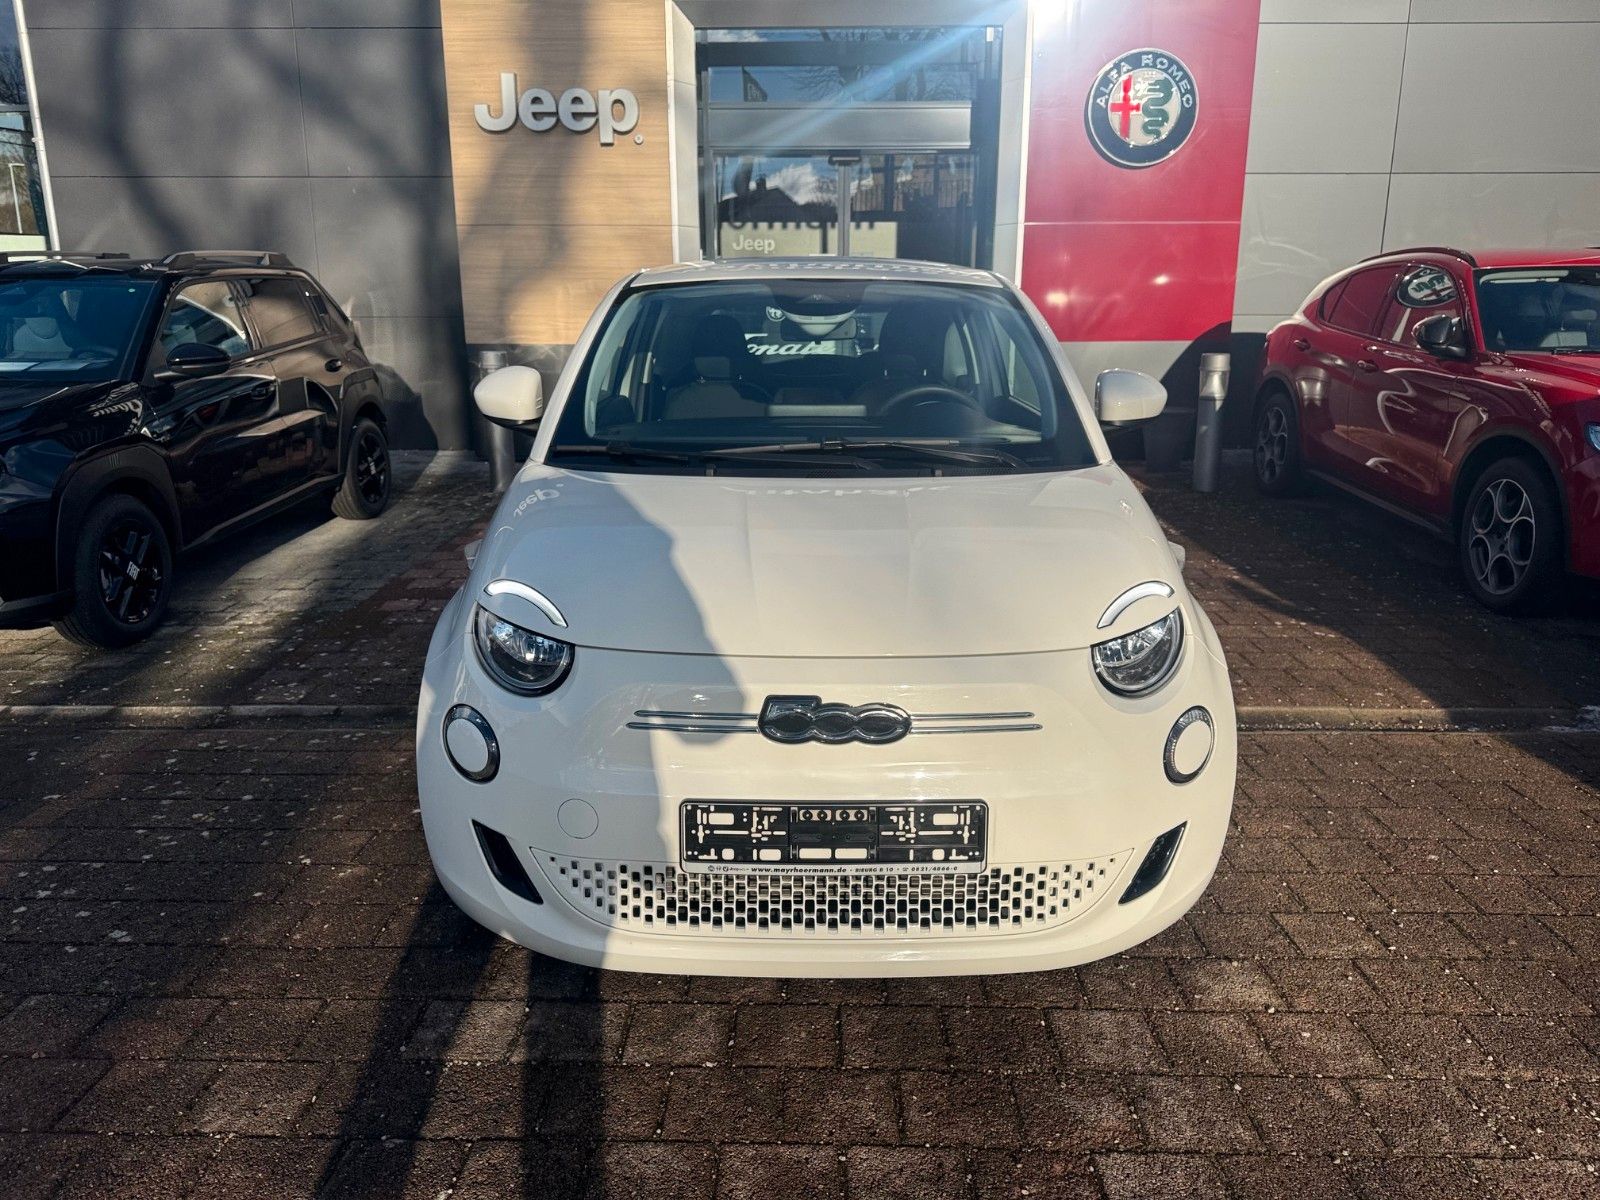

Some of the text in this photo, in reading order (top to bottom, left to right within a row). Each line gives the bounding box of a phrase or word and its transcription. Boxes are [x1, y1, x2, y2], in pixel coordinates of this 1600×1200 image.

[1096, 54, 1193, 109] ALFA ROMEO
[474, 72, 639, 146] Jeep
[732, 233, 776, 254] Jeep
[758, 694, 912, 745] 500
